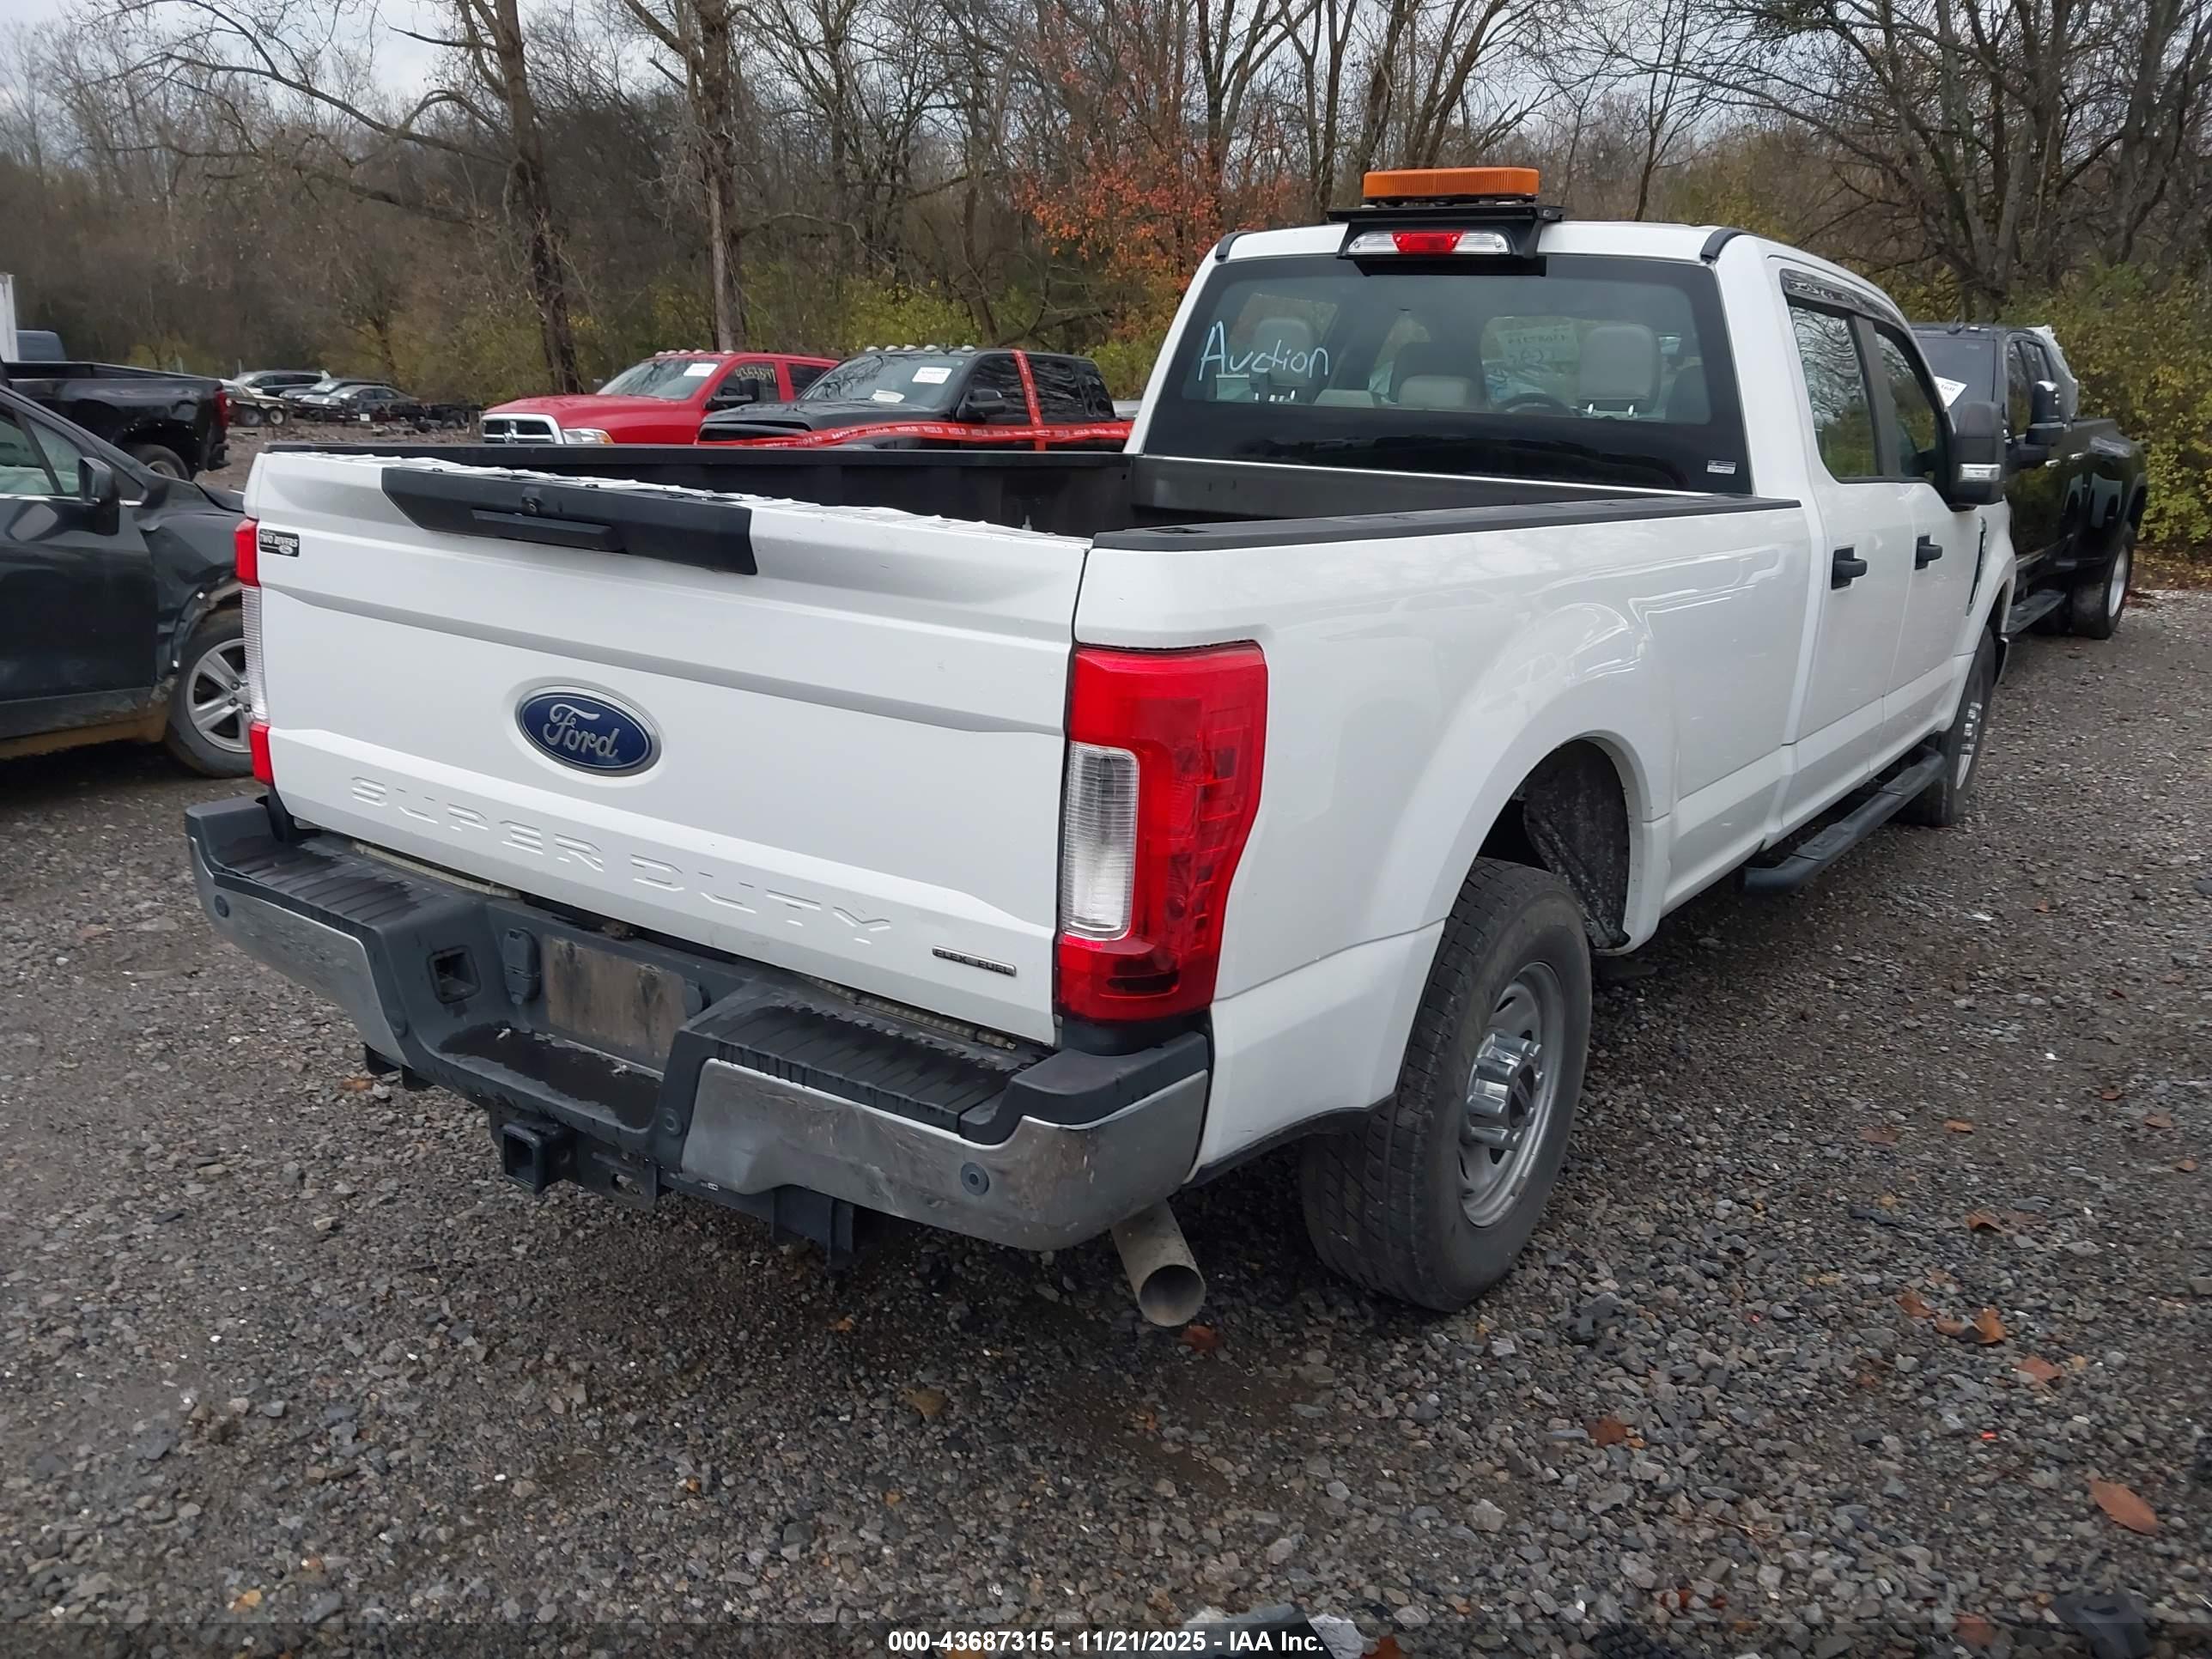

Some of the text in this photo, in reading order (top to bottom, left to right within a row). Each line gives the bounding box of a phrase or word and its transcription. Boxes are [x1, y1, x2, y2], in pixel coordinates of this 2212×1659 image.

[1198, 319, 1329, 381] Auction
[259, 533, 299, 549] TWO RIVERS
[542, 703, 621, 758] Ford
[350, 775, 892, 945] SUPER DUTY
